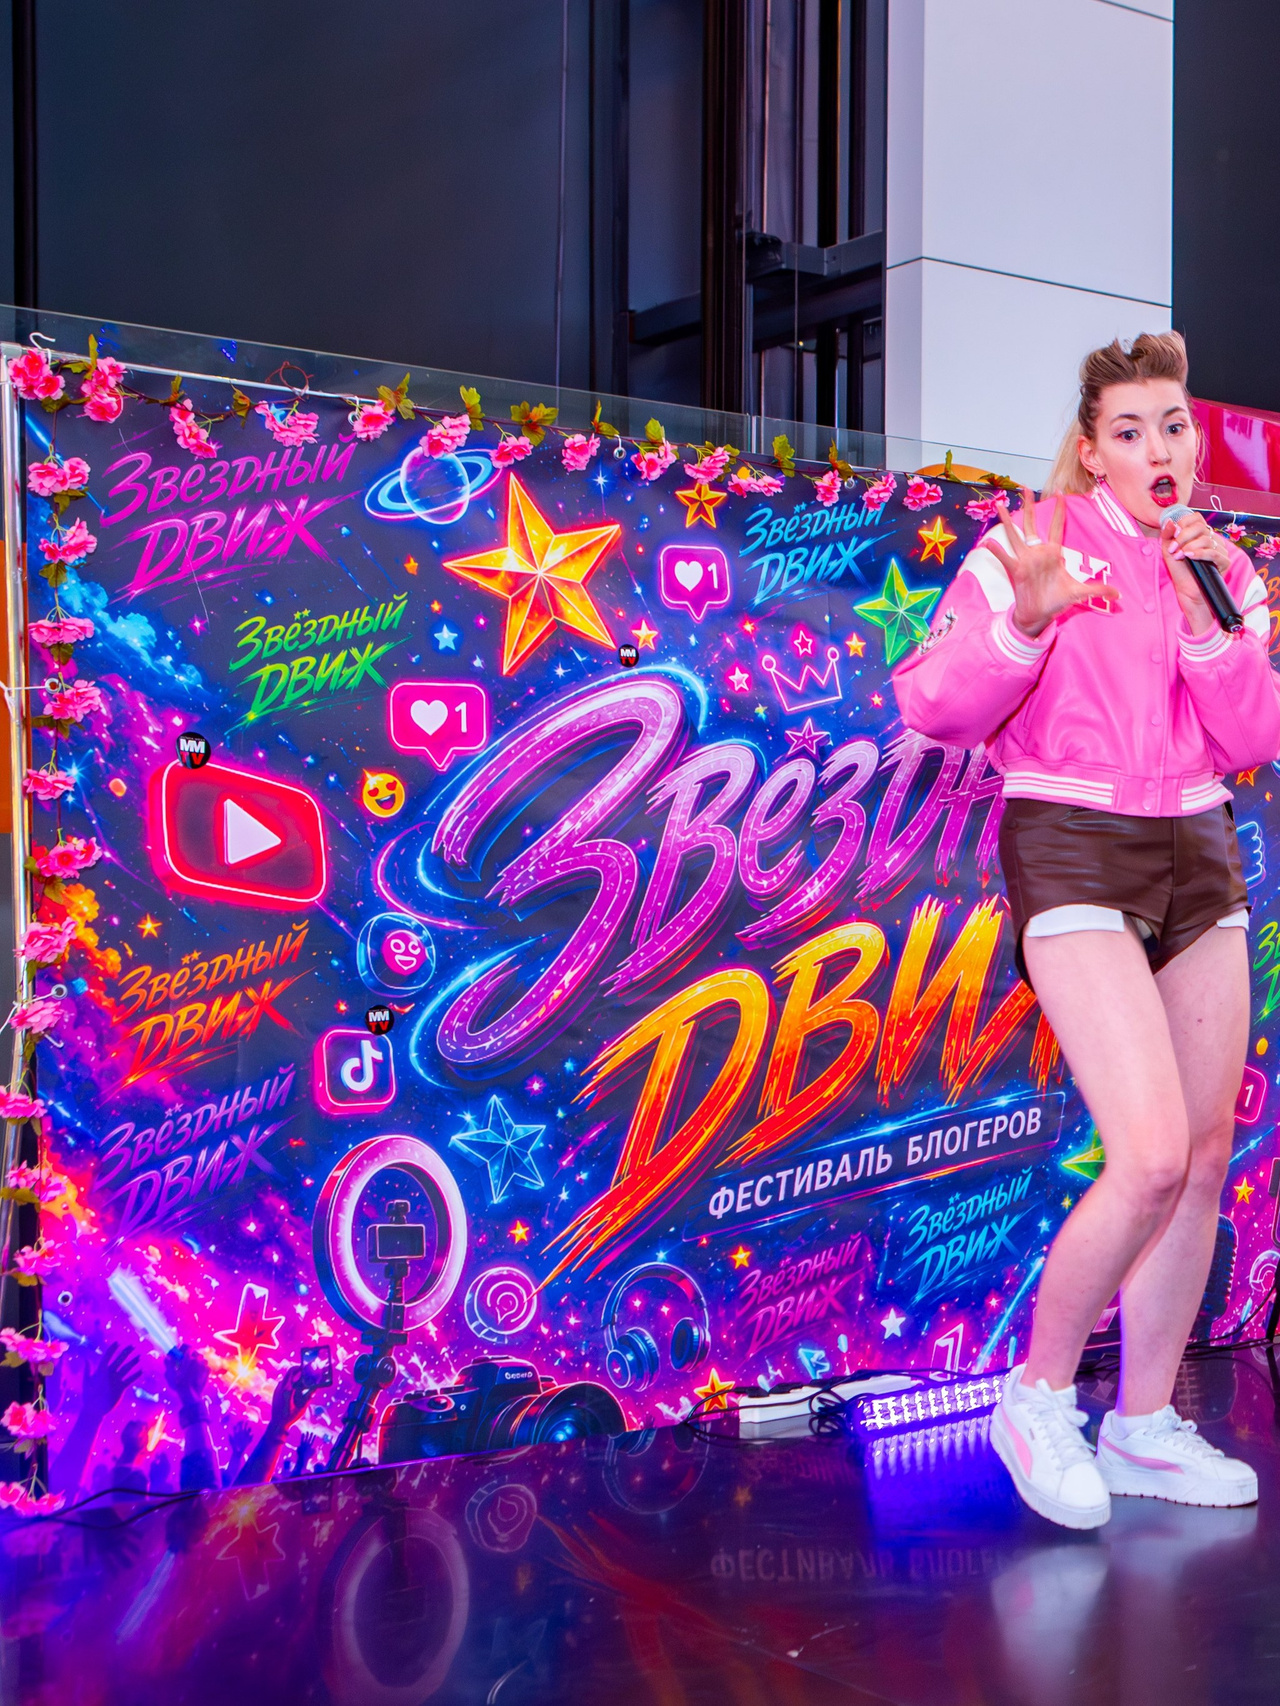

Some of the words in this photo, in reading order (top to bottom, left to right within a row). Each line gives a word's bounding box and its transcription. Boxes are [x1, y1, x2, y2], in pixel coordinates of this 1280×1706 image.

[95, 492, 350, 604] ДВИЖ
[744, 536, 882, 610] ДВИЖ
[230, 641, 400, 724] ДВИЖ
[180, 738, 205, 753] MM
[181, 751, 205, 765] TV
[116, 978, 303, 1085] ДВИЖ
[369, 1011, 389, 1022] MM
[370, 1021, 389, 1032] TV
[105, 1123, 288, 1242] ДВИЖ
[708, 1144, 892, 1220] ФЕСТИВАЛЬ
[906, 1107, 1042, 1165] БЛОГЕРОВ
[905, 1214, 1022, 1306] ДВИЖ
[742, 1276, 854, 1358] ДВИЖ
